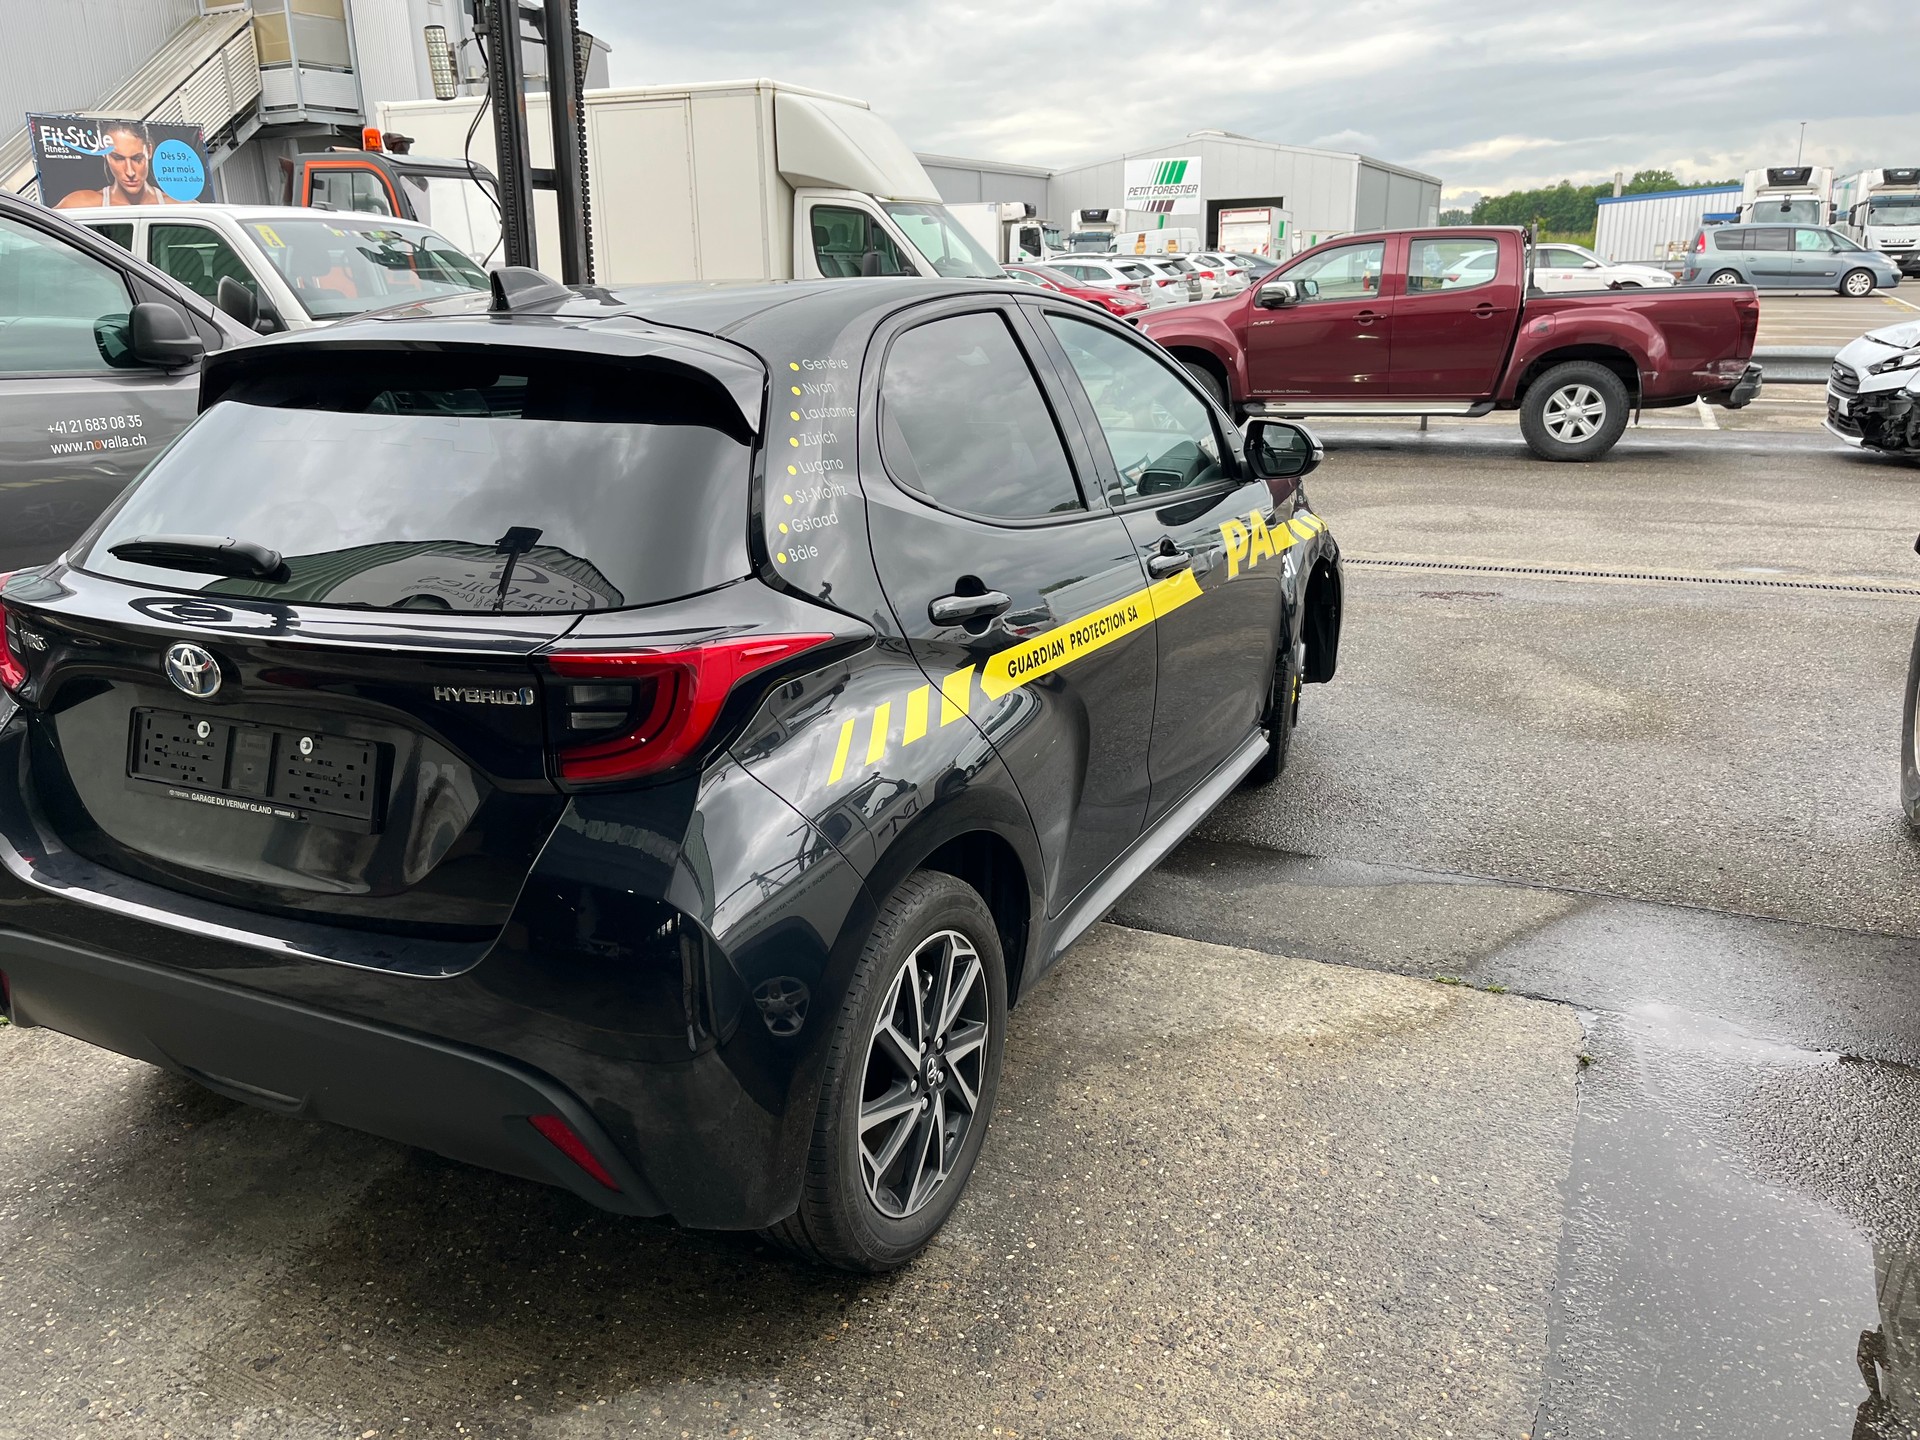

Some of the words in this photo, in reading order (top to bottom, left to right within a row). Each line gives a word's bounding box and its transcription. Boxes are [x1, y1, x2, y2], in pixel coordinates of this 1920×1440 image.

[39, 125, 115, 153] Fit-Style
[44, 145, 70, 153] Fitness
[160, 151, 176, 160] Dès
[162, 166, 175, 174] par
[176, 165, 196, 174] mois
[1127, 186, 1152, 196] PETIT
[1152, 184, 1199, 195] FORESTIER
[802, 356, 849, 371] Genève
[802, 381, 836, 396] Nyon
[800, 406, 856, 420] Lausanne
[47, 420, 68, 434] +41
[69, 419, 83, 433] 21
[84, 417, 108, 432] 683
[109, 416, 126, 430] 08
[127, 414, 143, 428] 35
[50, 433, 148, 454] www.novalla.ch
[800, 430, 838, 447] Zürich
[798, 456, 844, 475] Lugano
[795, 483, 849, 505] St-Moritz
[791, 511, 839, 534] Gstaad
[787, 544, 819, 563] Bâle
[1007, 637, 1065, 678] GUARDIAN
[1069, 609, 1127, 650] PROTECTION
[1127, 604, 1139, 622] SA
[433, 686, 518, 705] HYBRID
[191, 792, 216, 805] GARAGE
[216, 797, 226, 806] DU
[226, 799, 250, 811] VERNAY
[250, 803, 272, 815] GLAND
